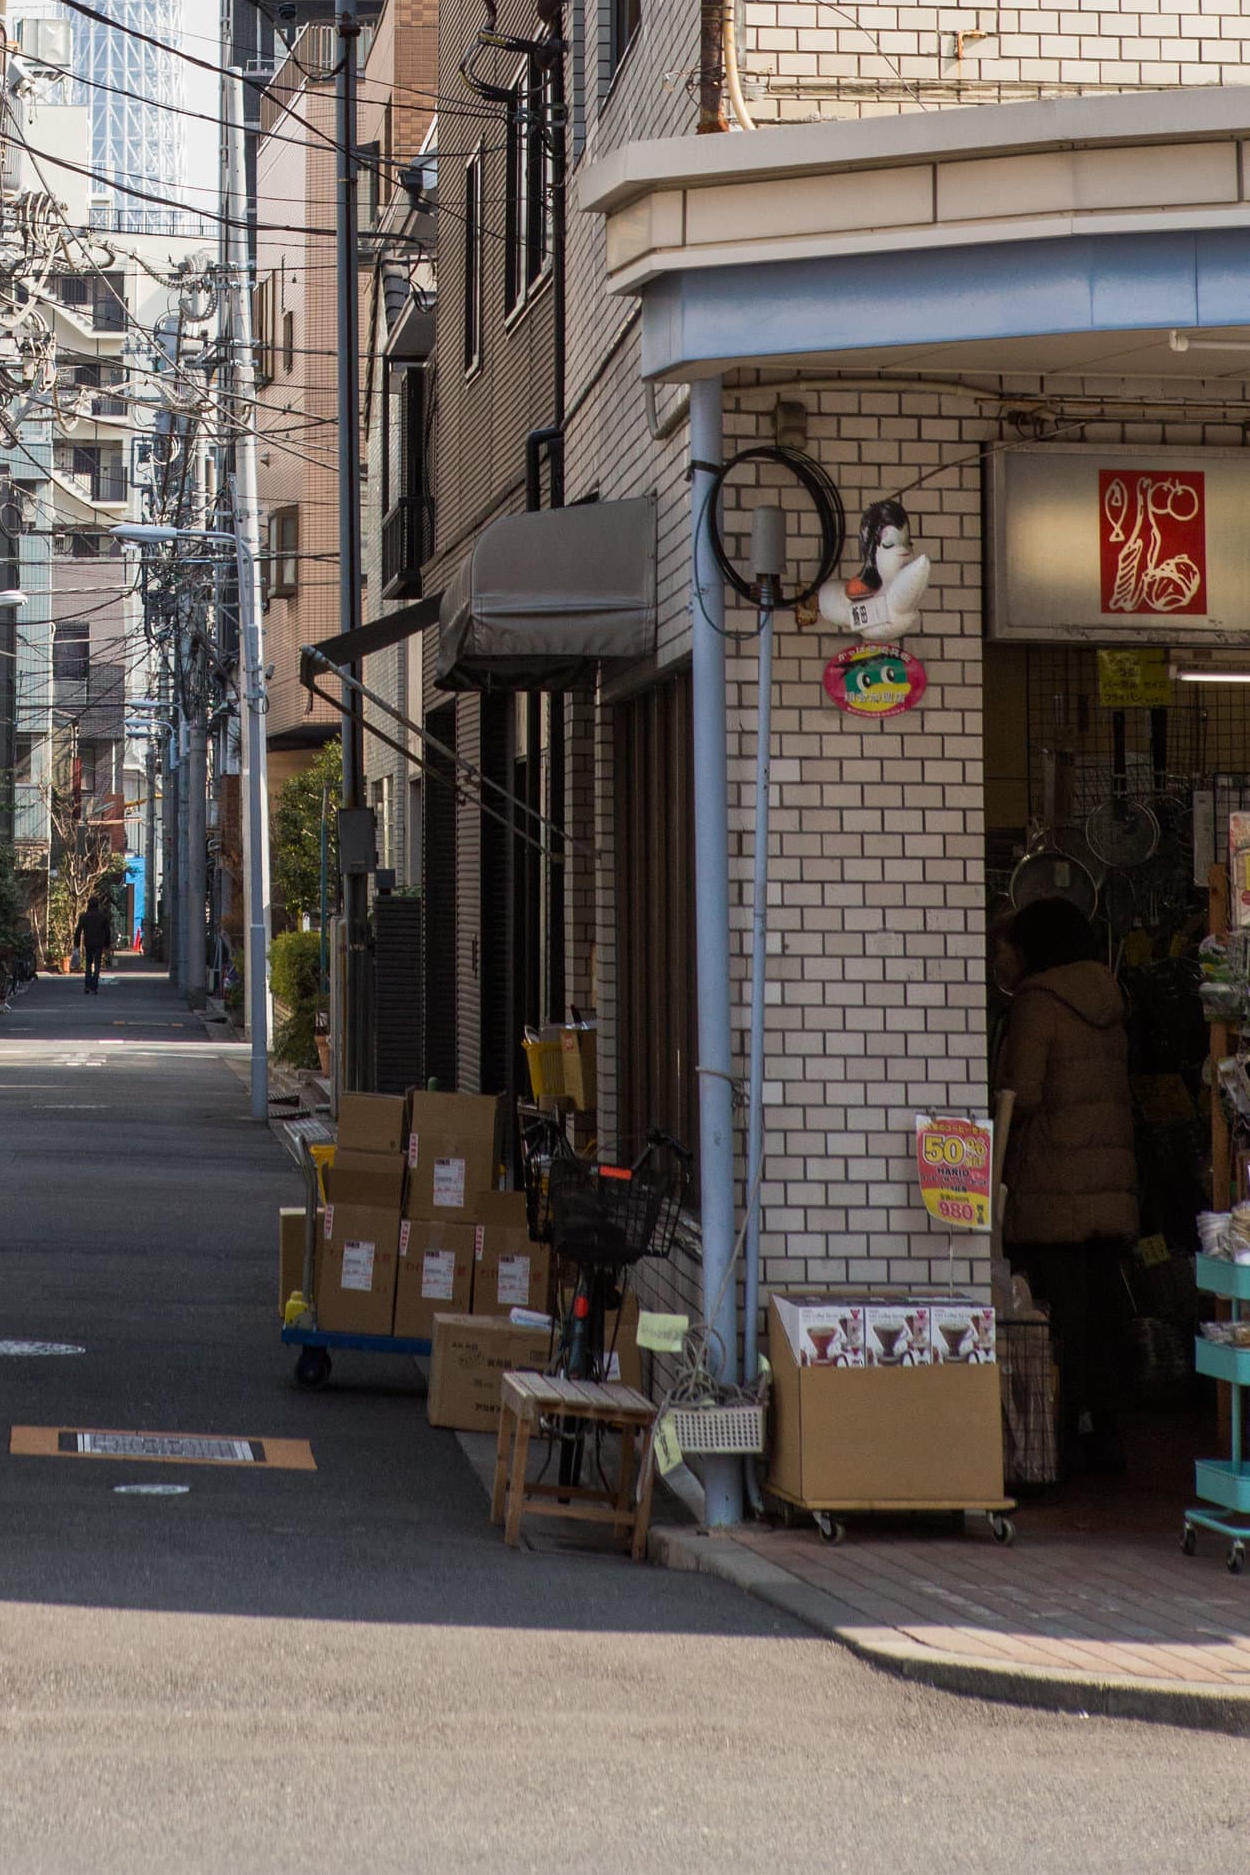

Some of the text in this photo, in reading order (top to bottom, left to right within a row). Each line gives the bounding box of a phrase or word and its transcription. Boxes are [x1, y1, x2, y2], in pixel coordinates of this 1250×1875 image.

[923, 1134, 987, 1166] 50%
[937, 1167, 970, 1177] HARIO
[938, 1200, 975, 1221] 980
